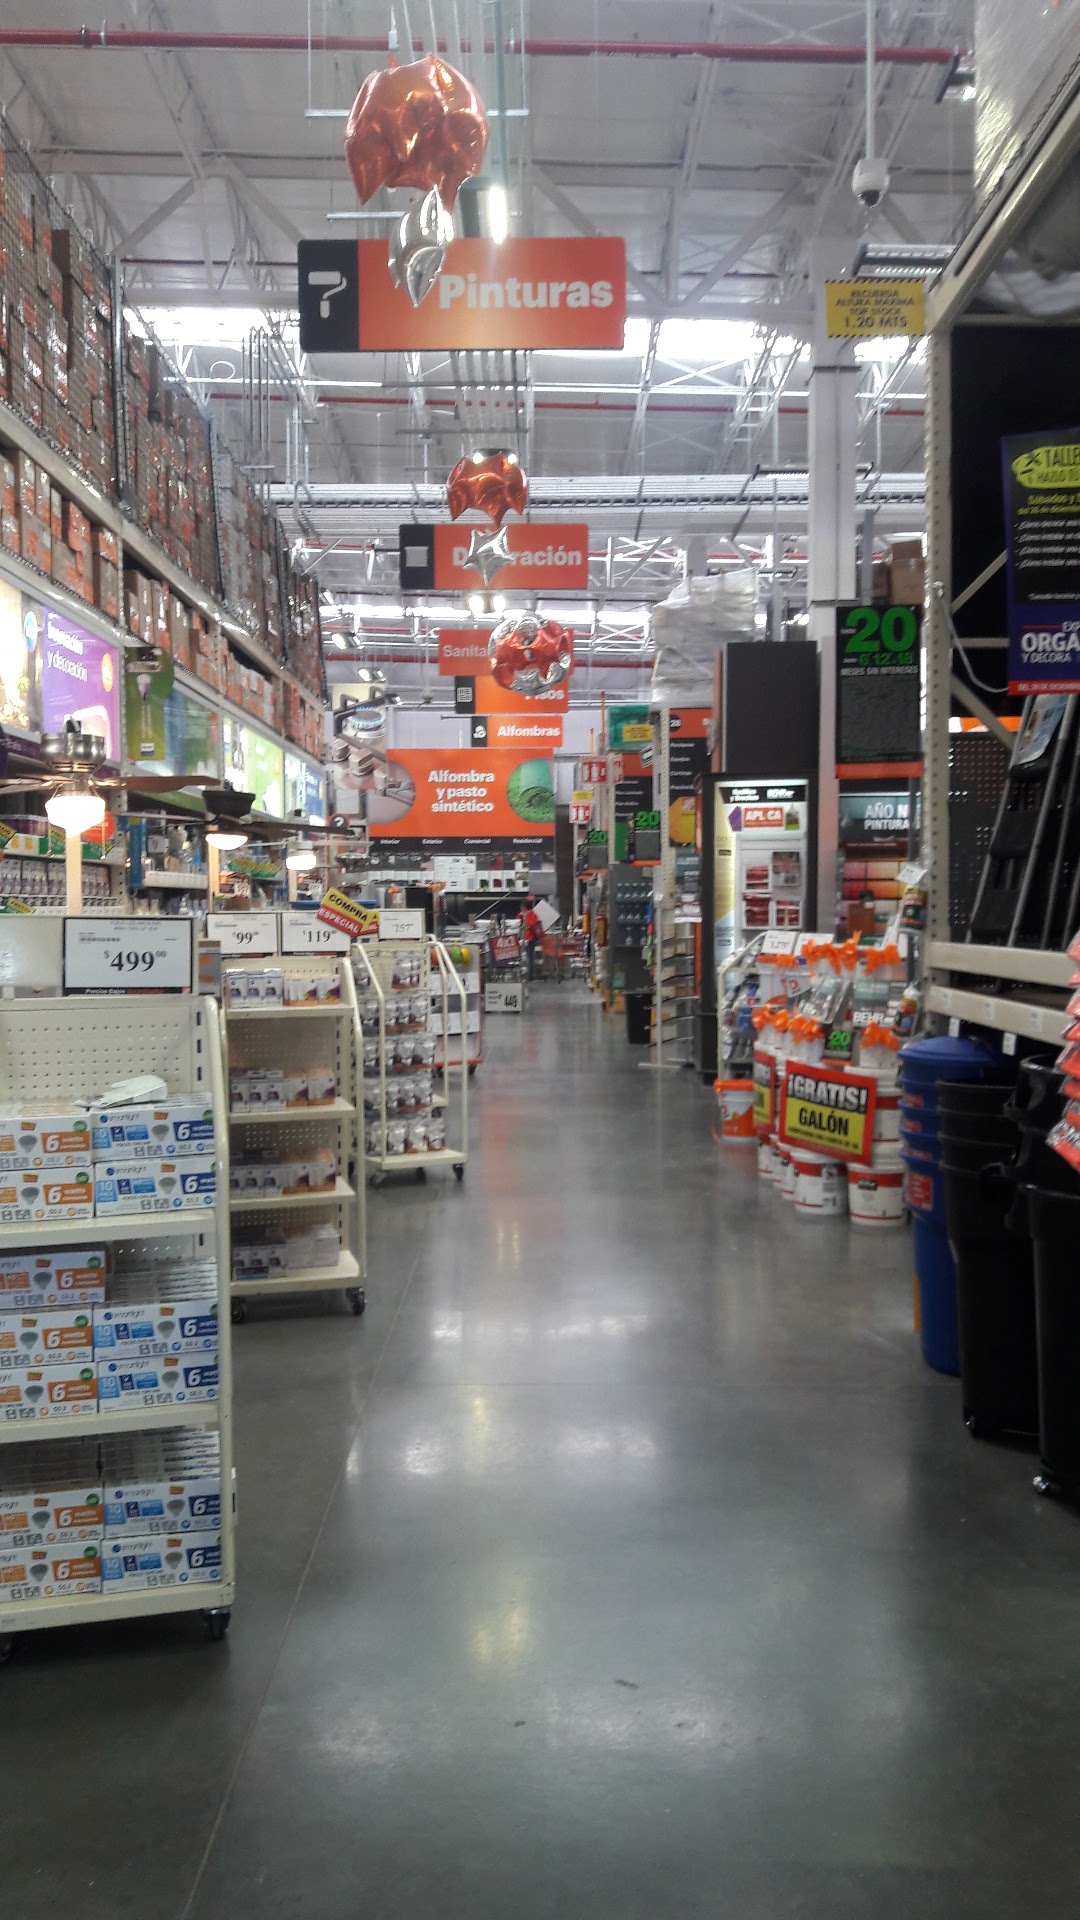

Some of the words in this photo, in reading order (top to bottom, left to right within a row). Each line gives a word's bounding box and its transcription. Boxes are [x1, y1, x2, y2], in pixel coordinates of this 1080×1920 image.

[439, 273, 613, 309] Pinturas
[844, 316, 875, 329] 1.20
[878, 315, 907, 328] MTS
[452, 545, 582, 566] Dración
[845, 606, 917, 653] 20
[442, 645, 490, 657] Sanita
[497, 725, 560, 737] Alfombras
[427, 770, 495, 783] Alfombra
[436, 788, 444, 799] y
[446, 787, 487, 800] pasto
[431, 799, 495, 813] sintético
[864, 802, 894, 819] AÑO
[636, 811, 660, 827] 20
[329, 894, 369, 922] COMPRA
[318, 908, 360, 933] ESPECIAL
[829, 1031, 852, 1046] 20
[787, 1073, 868, 1111] ¡GRATIS!
[799, 1107, 849, 1137] GALÓN
[178, 1123, 190, 1140] 6
[46, 1134, 60, 1152] 6
[184, 1175, 198, 1193] 6
[48, 1186, 62, 1204] 6
[60, 1271, 74, 1289] 6
[184, 1319, 197, 1336] 6
[47, 1330, 61, 1348] 6
[187, 1369, 201, 1386] 6
[52, 1384, 66, 1401] 6
[192, 1498, 207, 1514] 6
[58, 1509, 73, 1527] 6
[190, 1550, 204, 1567] 6
[56, 1562, 71, 1580] 6
